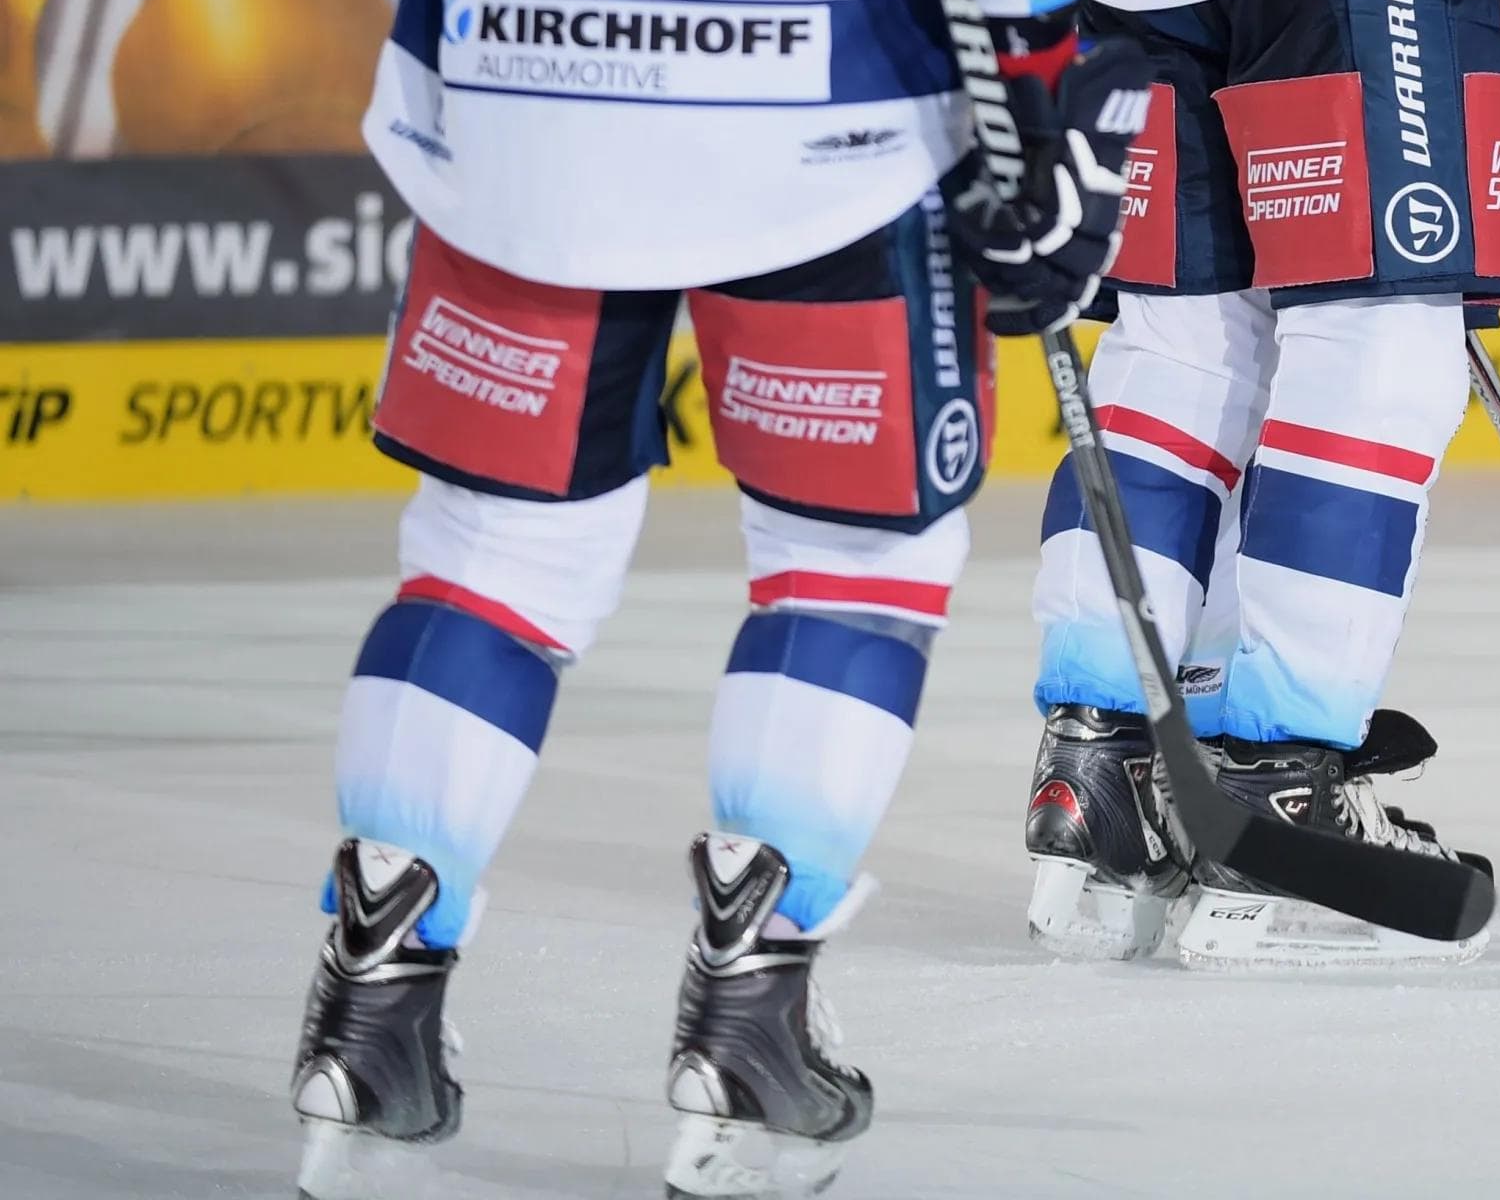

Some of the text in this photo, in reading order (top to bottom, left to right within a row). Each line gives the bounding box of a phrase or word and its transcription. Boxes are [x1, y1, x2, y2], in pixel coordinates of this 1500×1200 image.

[480, 5, 812, 55] KIRCHHOFF
[476, 53, 667, 92] AUTOMOTIVE
[1247, 141, 1347, 183] WINNER
[1247, 180, 1342, 222] SPEDITION
[420, 296, 568, 379] WINNER
[402, 330, 550, 417] SPEDITION
[727, 355, 885, 407] WINNER
[120, 379, 374, 445] SPORTW
[720, 388, 880, 445] SPEDITION
[1209, 910, 1257, 921] CCM
